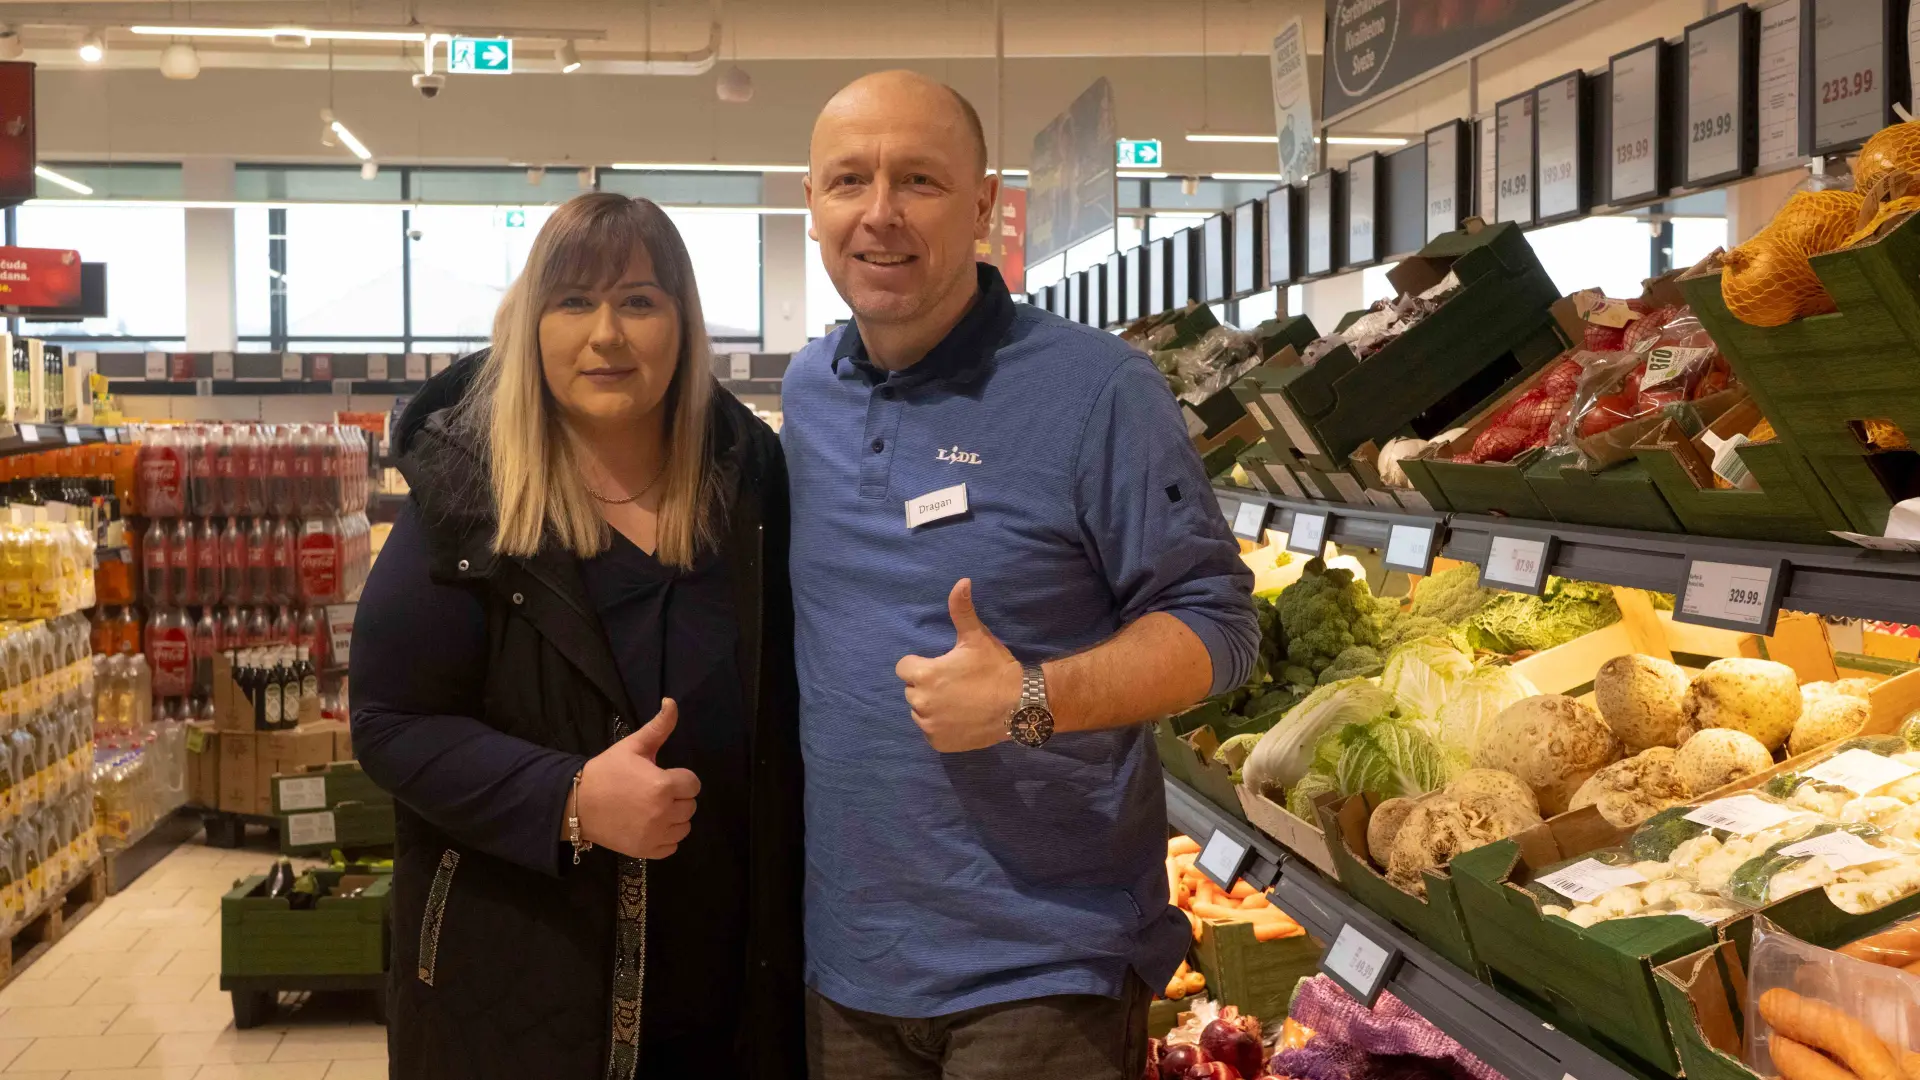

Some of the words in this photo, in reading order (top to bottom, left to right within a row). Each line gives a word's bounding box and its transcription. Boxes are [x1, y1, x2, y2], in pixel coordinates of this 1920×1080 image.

[1352, 48, 1376, 76] Sveže
[1822, 68, 1873, 105] 233.99
[1692, 112, 1731, 143] 239.99
[1616, 138, 1648, 164] 139.99
[1501, 174, 1526, 199] 64.99
[918, 497, 952, 514] Dragan
[1728, 588, 1759, 605] 329.99
